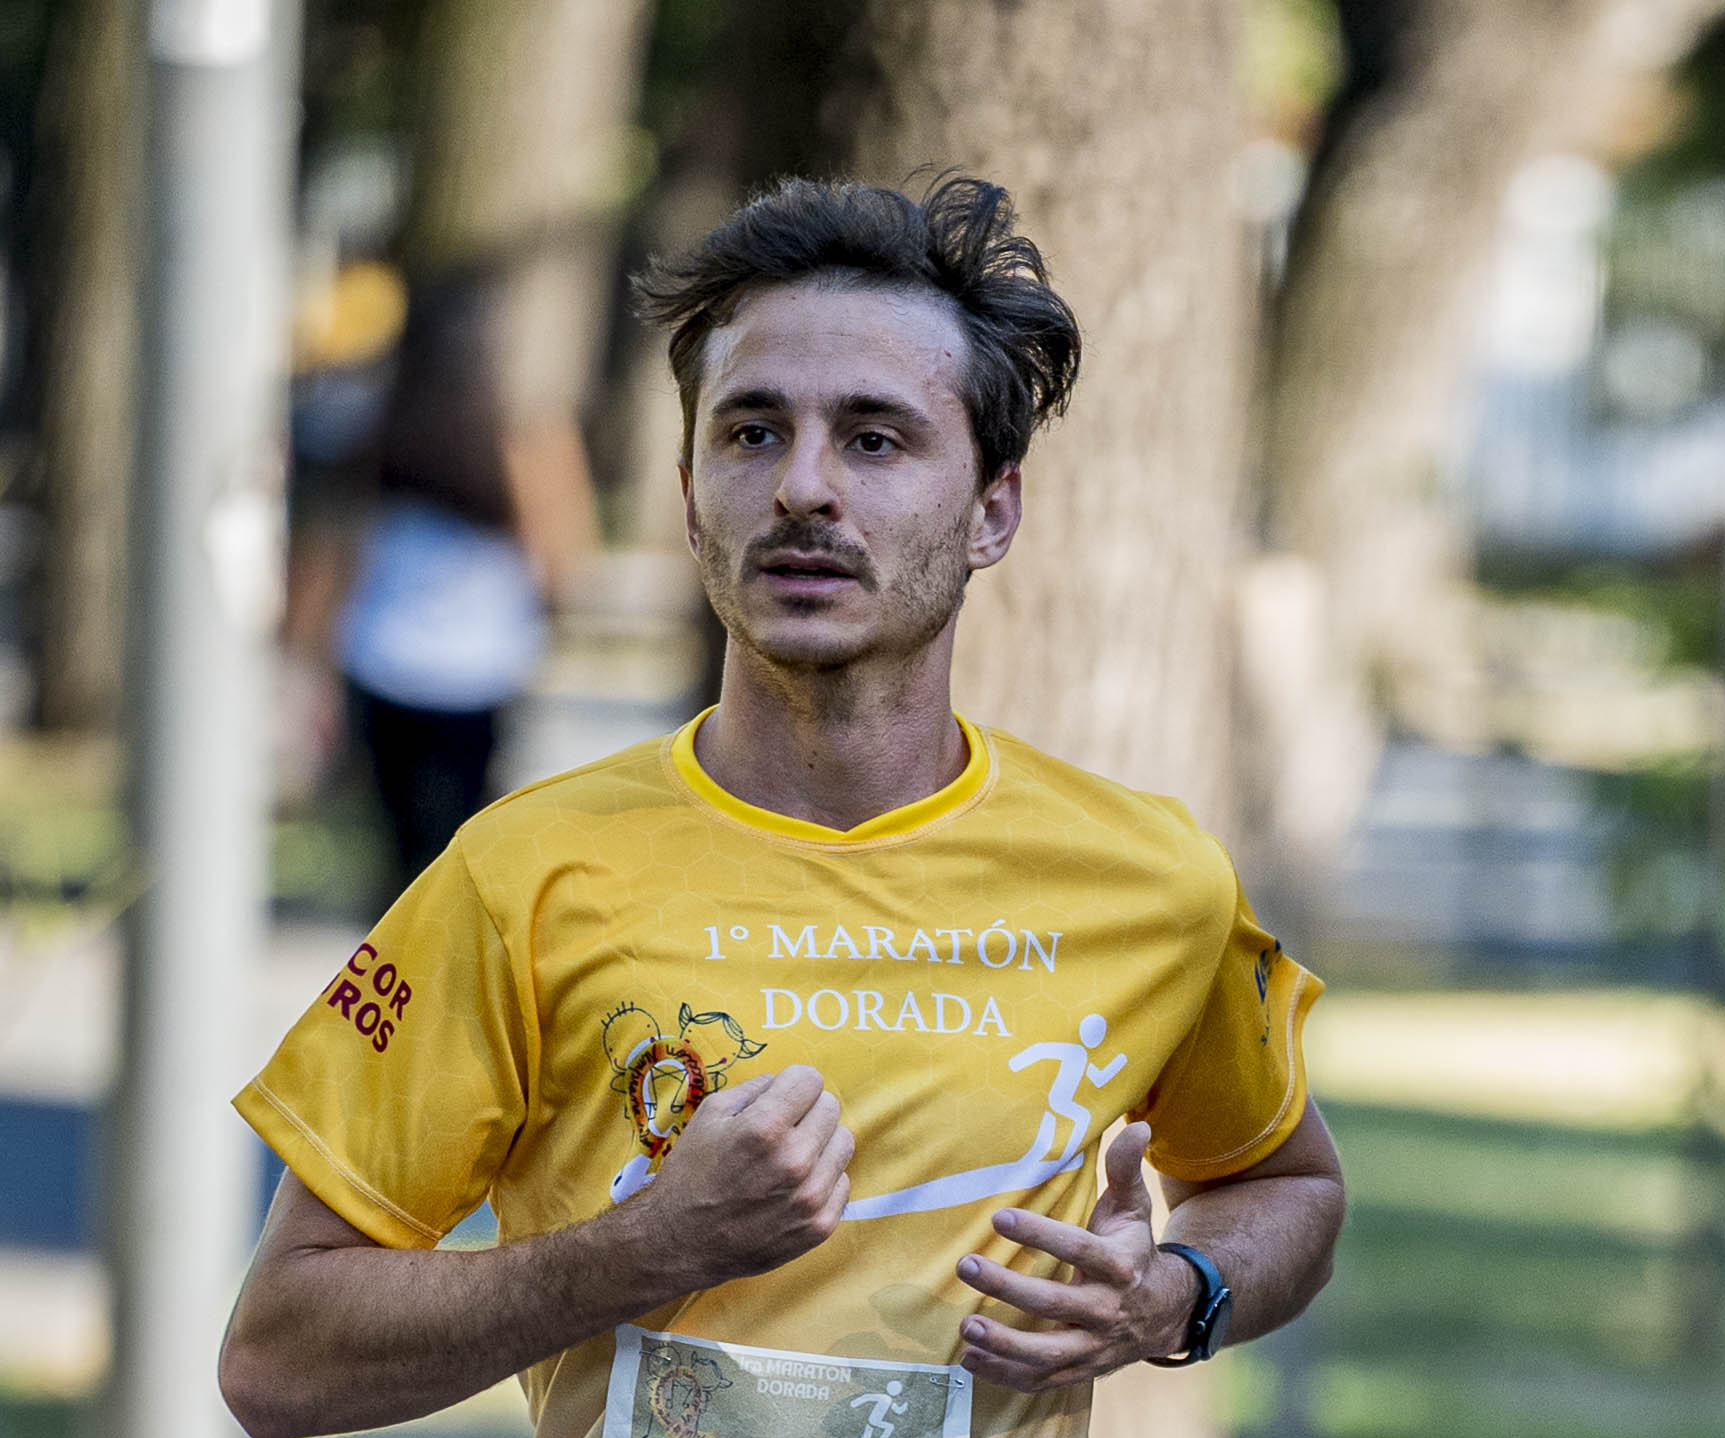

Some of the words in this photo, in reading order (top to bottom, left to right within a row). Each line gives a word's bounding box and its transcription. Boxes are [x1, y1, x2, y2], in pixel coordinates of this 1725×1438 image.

[768, 919, 1062, 973] MARATÓN
[323, 973, 395, 1053] ROS
[761, 988, 1011, 1037] DORADA
[757, 1379, 830, 1401] DORADA
